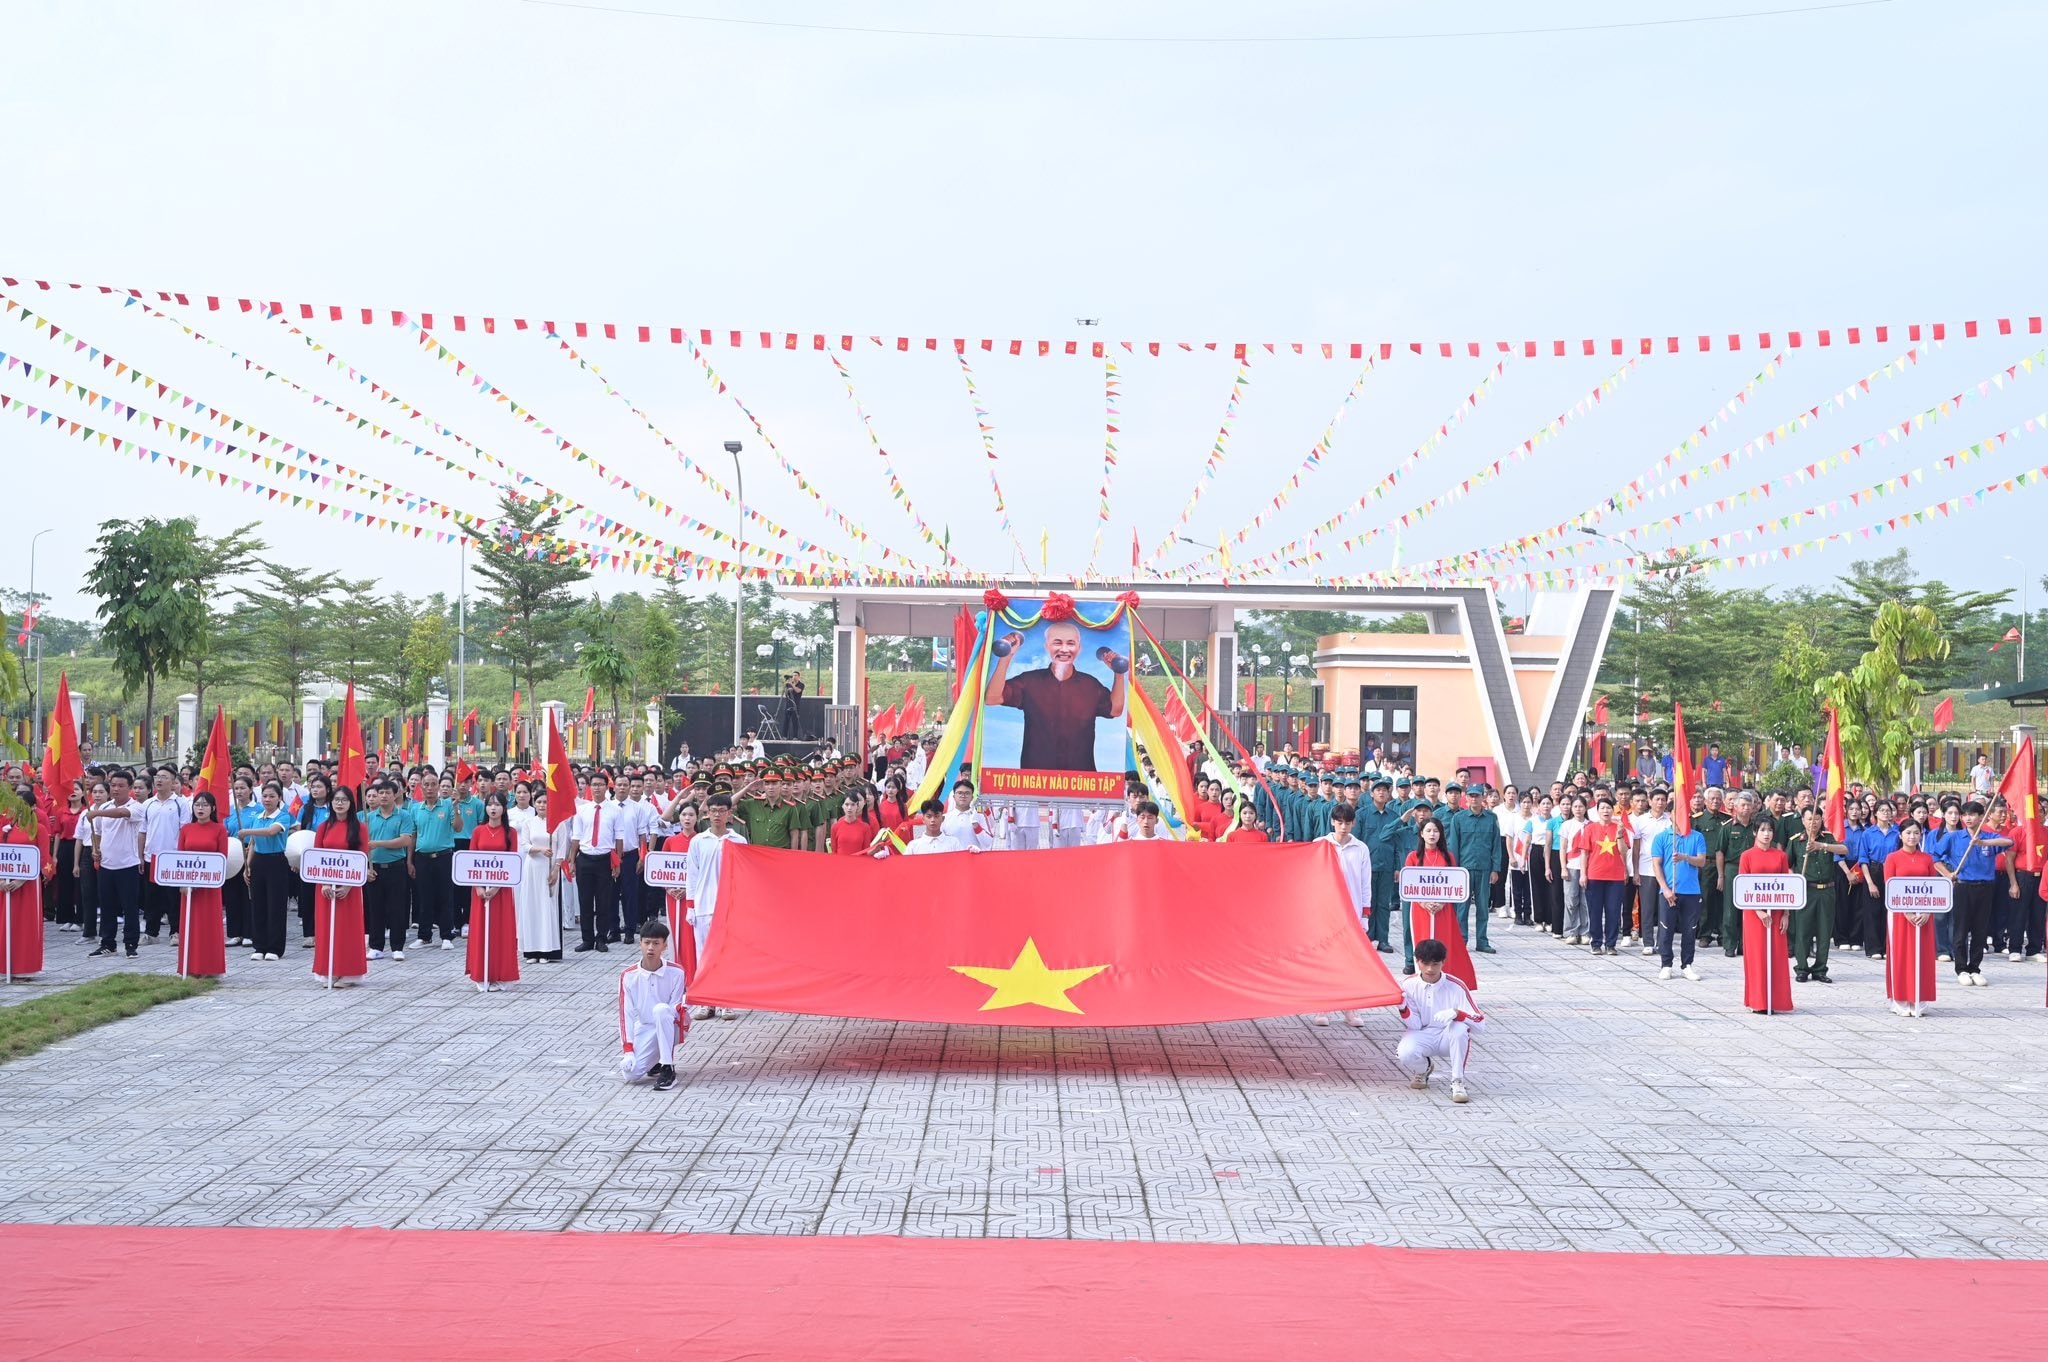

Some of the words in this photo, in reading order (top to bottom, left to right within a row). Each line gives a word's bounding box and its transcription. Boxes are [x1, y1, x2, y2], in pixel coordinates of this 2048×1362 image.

[1007, 773, 1021, 788] TÔI
[1023, 773, 1047, 789] NGÀY
[1049, 775, 1069, 791] NÀO
[1071, 775, 1096, 791] CŨNG
[0, 849, 22, 861] HỐI
[321, 854, 349, 867] KHỐI
[17, 862, 30, 873] TÀI
[176, 856, 206, 869] KHỐI
[473, 856, 504, 868] KHỐI
[665, 857, 687, 870] KHỐ
[161, 868, 171, 881] HỘI
[172, 868, 185, 880] LIÊN
[186, 870, 199, 882] HIỆP
[200, 871, 211, 883] PHỤ
[212, 870, 222, 881] NỮ
[307, 865, 320, 878] HỘI
[322, 867, 344, 878] NÔNG
[346, 869, 361, 880] DÂN
[485, 869, 509, 880] THỨC
[651, 869, 676, 881] CÔNG
[1419, 871, 1449, 884] KHỐI
[1404, 884, 1420, 896] DÂN
[1422, 885, 1442, 896] QUÂN
[1443, 886, 1453, 898] TỰ
[1454, 885, 1463, 898] VỆ
[1754, 878, 1785, 891] KHỐI
[1905, 881, 1933, 894] KHỐI
[1744, 890, 1754, 902] ỦY
[1756, 894, 1772, 902] BAN
[1774, 894, 1795, 904] MTTQ
[1892, 894, 1901, 908] HỘI
[1914, 894, 1932, 906] CHIẾN
[1932, 897, 1946, 906] BINH
